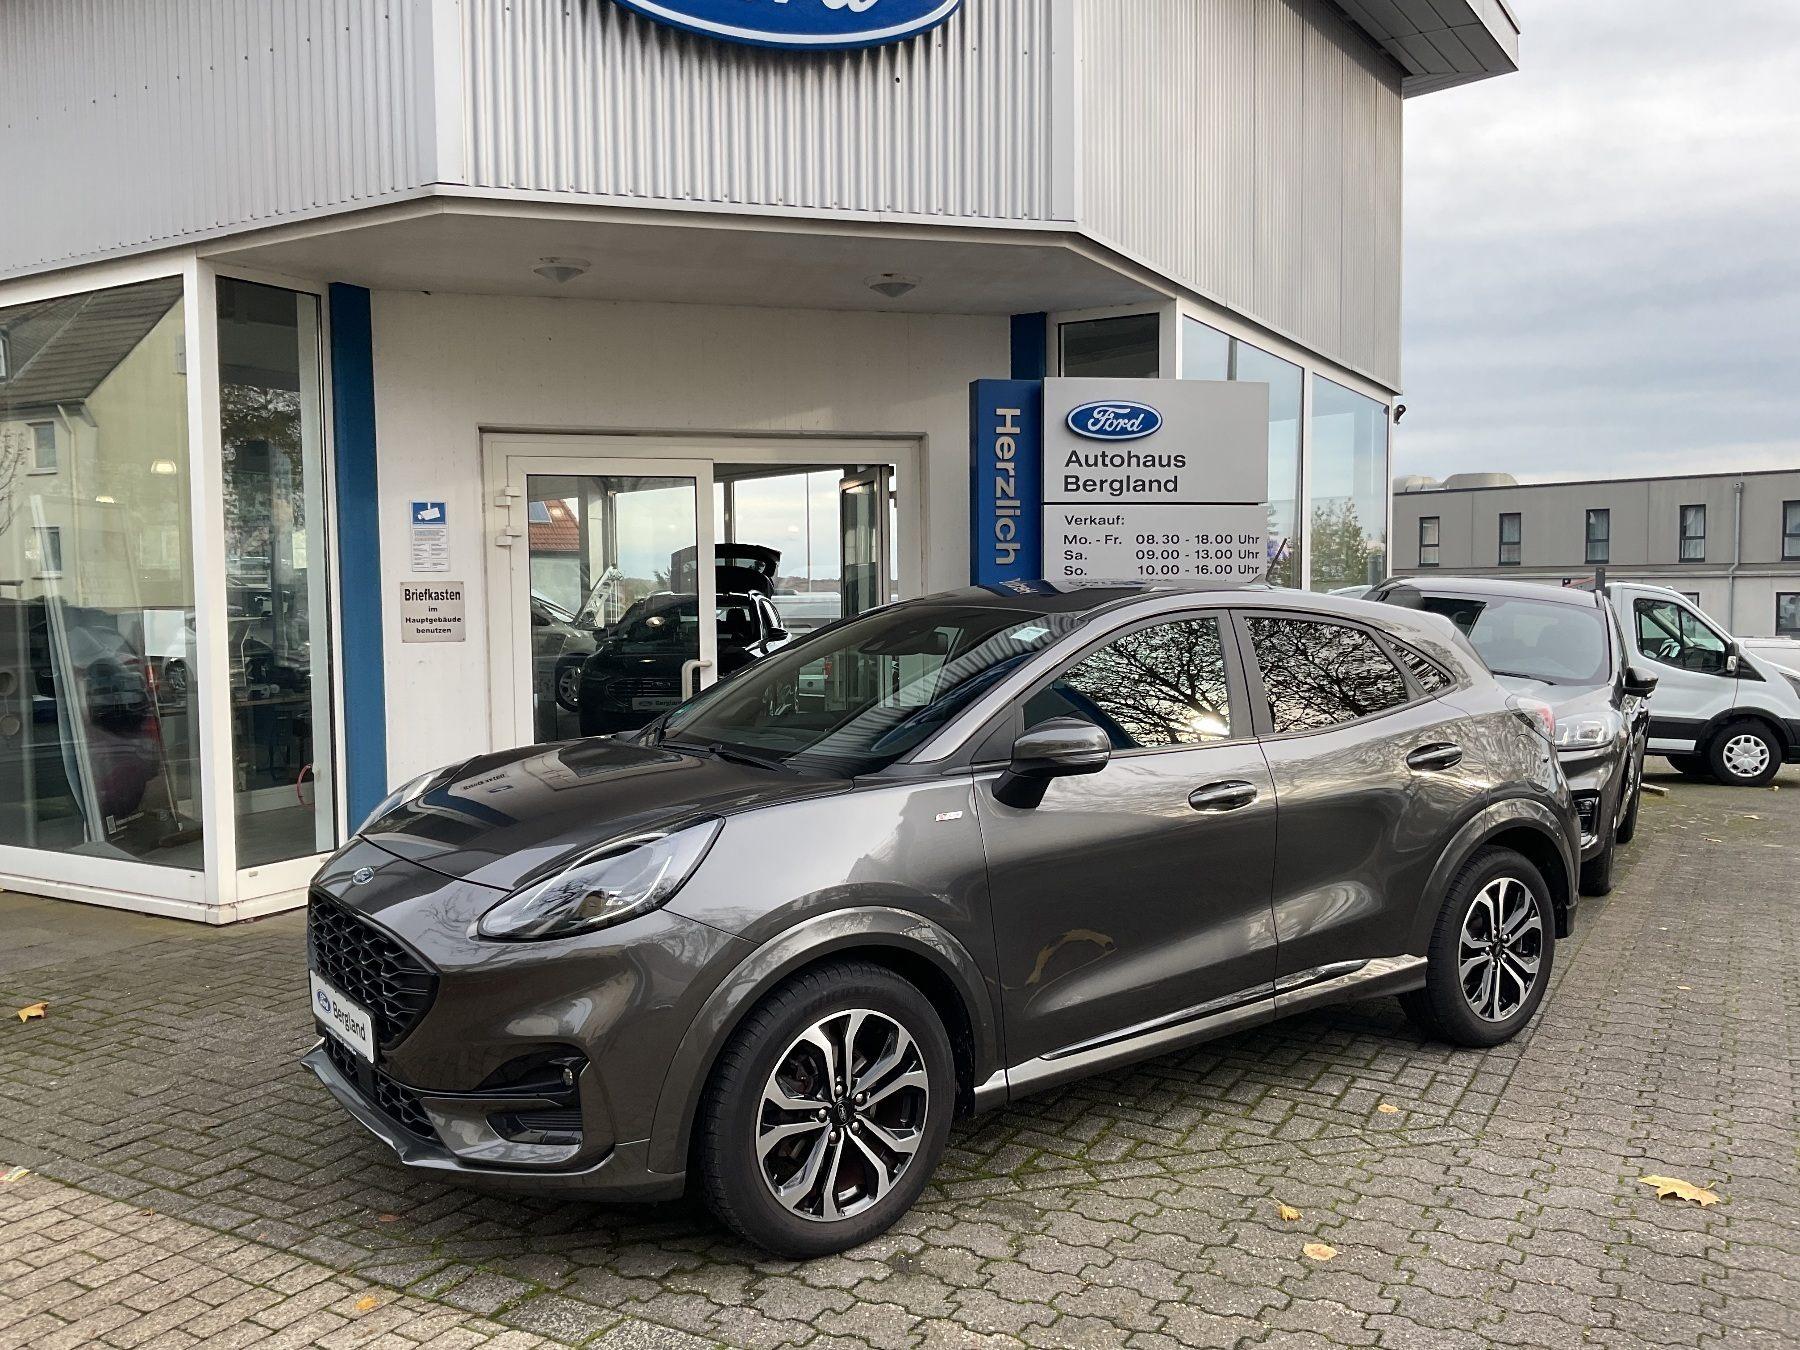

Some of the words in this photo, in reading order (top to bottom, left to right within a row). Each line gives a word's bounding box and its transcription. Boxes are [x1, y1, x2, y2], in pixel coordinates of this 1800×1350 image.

[1087, 406, 1145, 432] Ford
[1064, 449, 1187, 469] Autohaus
[995, 408, 1021, 565] Herzlich
[1063, 474, 1178, 497] Bergland
[1064, 514, 1125, 526] Verkauf:
[1063, 534, 1092, 545] Mo.
[1104, 534, 1122, 545] Fr.
[1135, 534, 1180, 545] 08.30
[1194, 534, 1233, 545] 18.00
[1238, 534, 1260, 545] Uhr
[1063, 549, 1088, 560] Sa.
[1135, 549, 1180, 560] 09.00
[1194, 549, 1233, 560] 13.00
[1238, 549, 1260, 560] Uhr
[1063, 565, 1088, 576] So.
[1137, 565, 1180, 575] 10.00
[1194, 564, 1233, 575] 16.00
[1238, 564, 1260, 575] Uhr
[404, 588, 461, 601] Briefkasten
[405, 616, 462, 625] Hauptgebäude
[332, 1000, 366, 1041] Bergland
